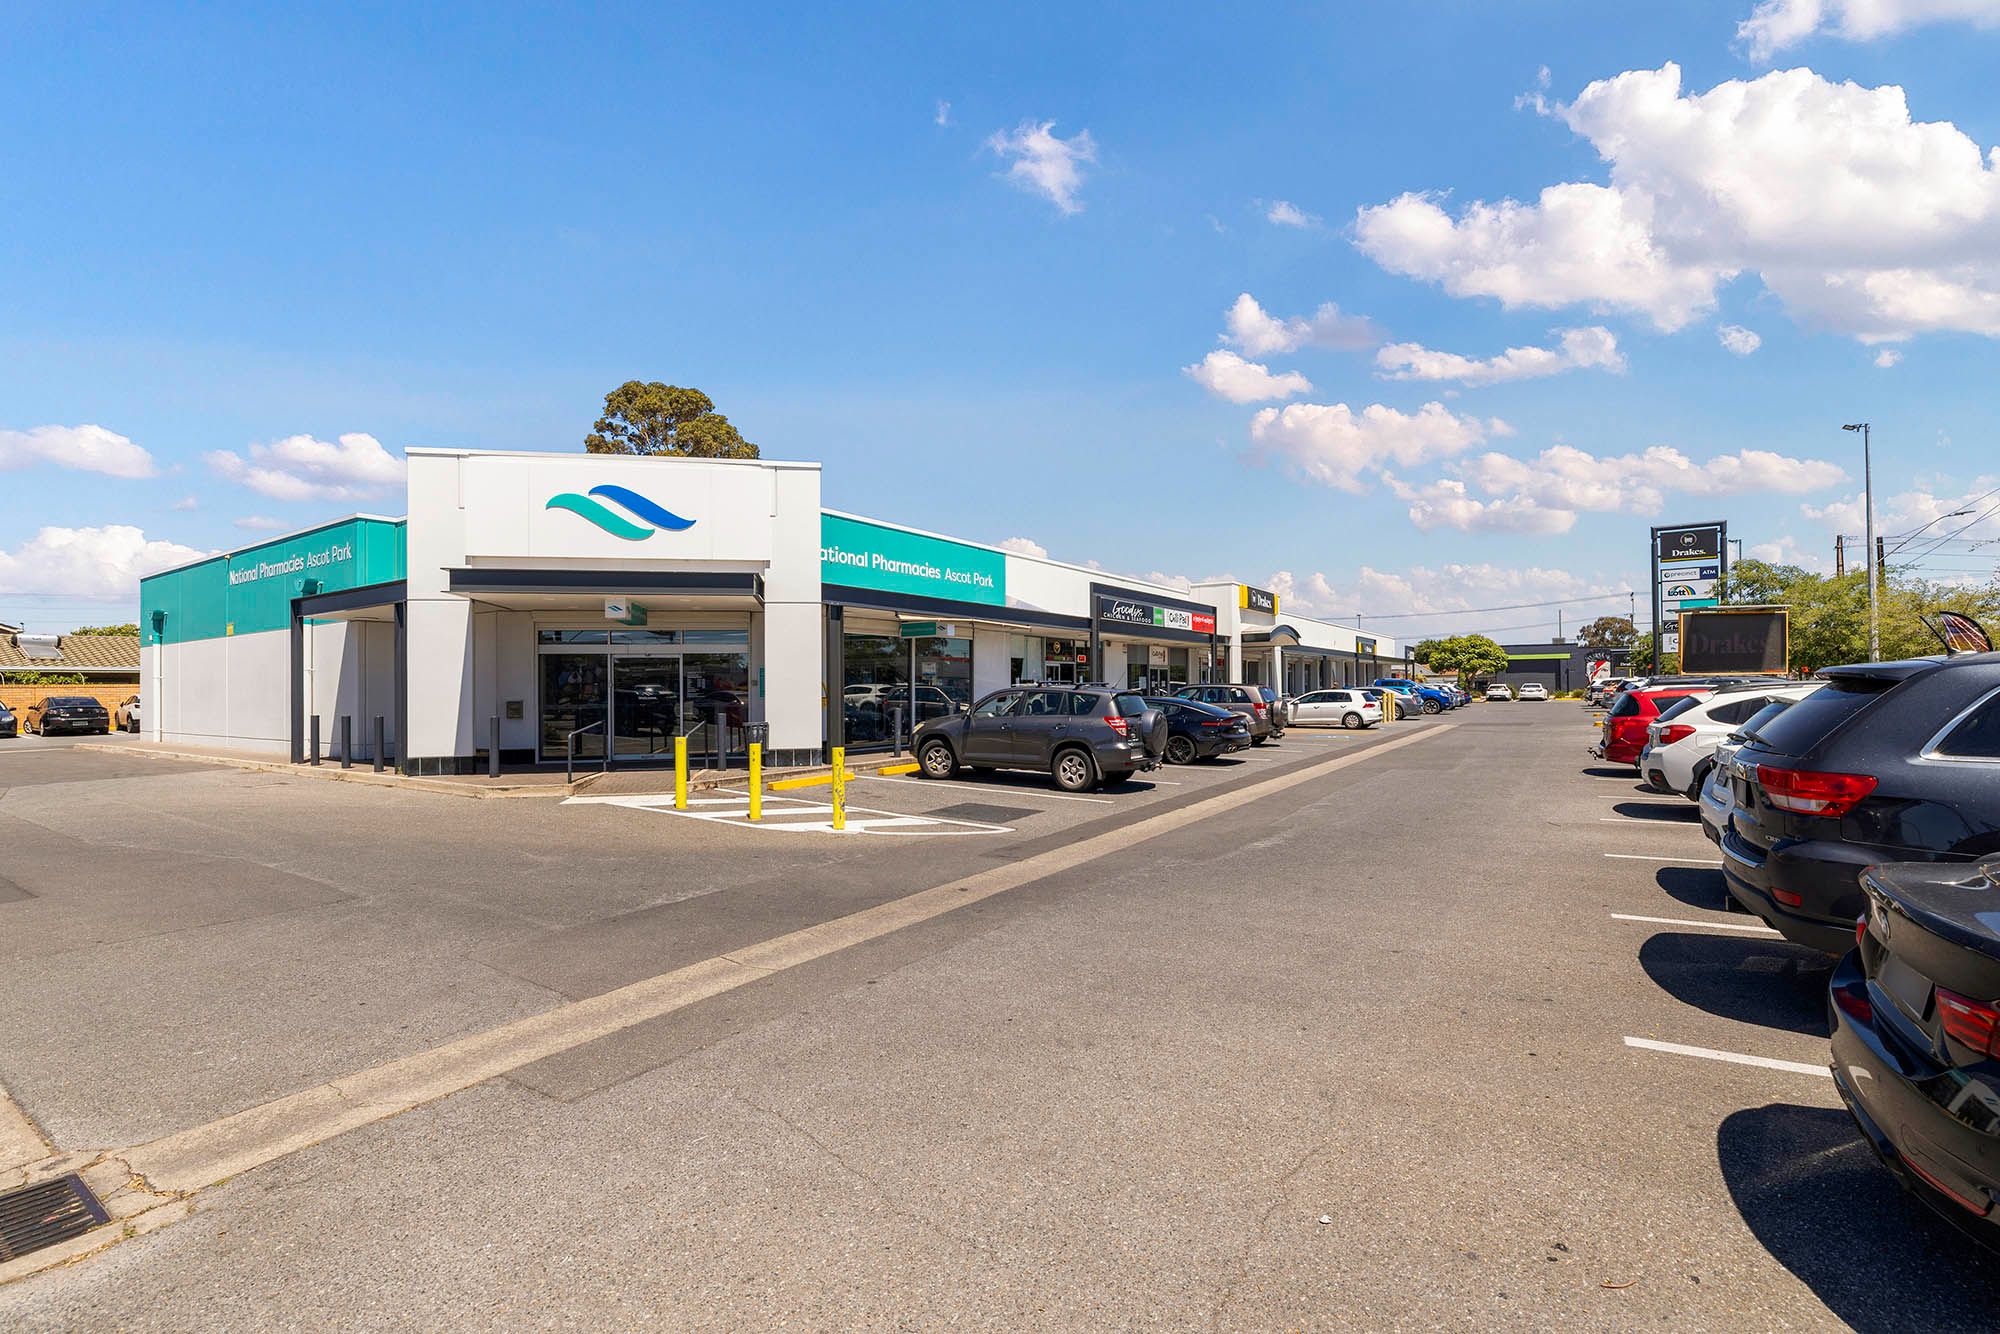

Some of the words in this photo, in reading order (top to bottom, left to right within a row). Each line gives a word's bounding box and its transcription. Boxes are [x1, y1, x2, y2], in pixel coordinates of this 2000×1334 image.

[229, 565, 258, 585] National
[259, 554, 304, 580] Pharmacies
[306, 549, 330, 568] Ascot
[331, 542, 352, 562] Park
[819, 545, 868, 568] ational
[872, 553, 941, 579] Pharmacies
[944, 567, 972, 584] Ascot
[973, 572, 994, 588] Park
[1103, 612, 1125, 620] CHICKEN
[1131, 616, 1152, 624] SEAFOOD
